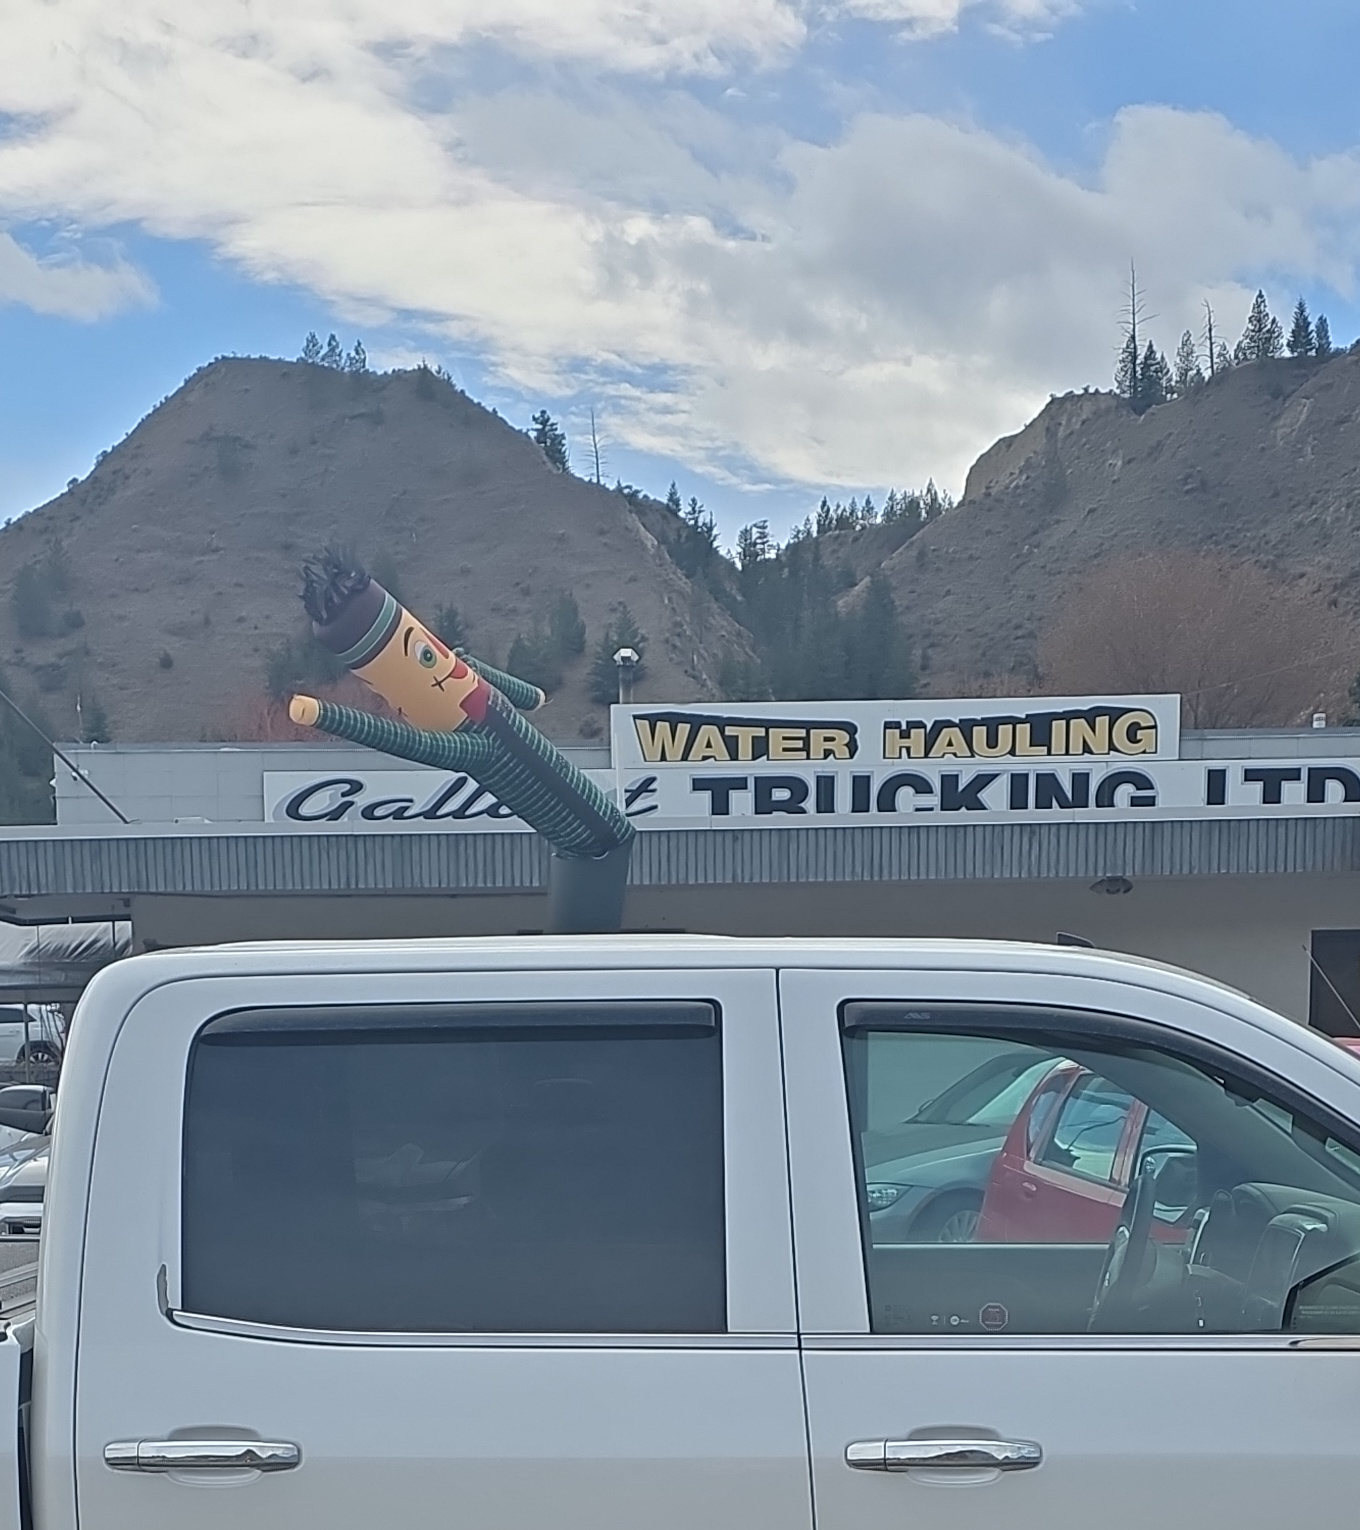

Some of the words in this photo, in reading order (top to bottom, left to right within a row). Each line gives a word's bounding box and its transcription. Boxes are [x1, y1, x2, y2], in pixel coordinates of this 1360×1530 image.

[633, 711, 859, 762] WATER
[883, 706, 1157, 759] HAULING
[285, 776, 658, 822] Gallt
[691, 770, 1156, 816] TRUCKING
